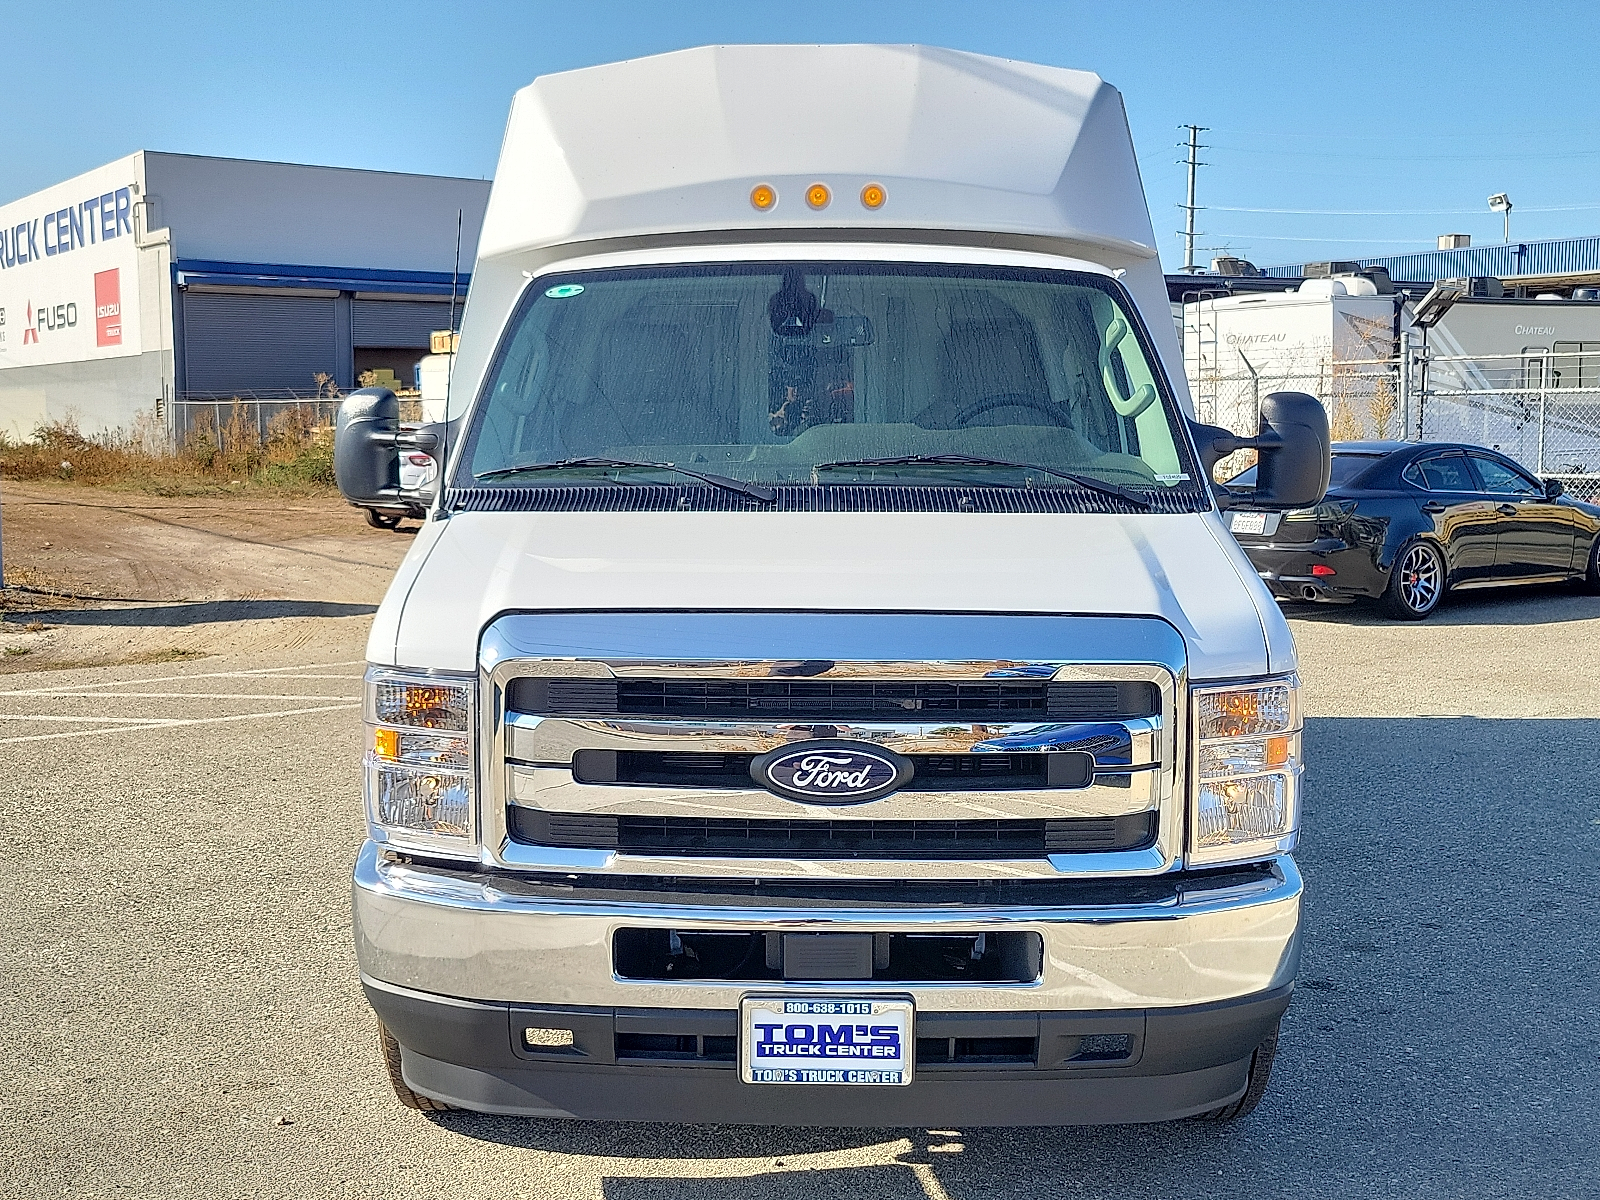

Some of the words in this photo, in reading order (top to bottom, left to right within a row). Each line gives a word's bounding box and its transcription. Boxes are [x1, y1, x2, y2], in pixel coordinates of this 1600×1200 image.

[44, 186, 132, 257] CENTER
[37, 302, 77, 332] FUSO
[97, 302, 120, 318] ISUZU
[793, 756, 872, 787] Ford
[786, 1002, 869, 1014] 800-638-1015
[754, 1024, 901, 1045] TOM'S
[761, 1044, 821, 1056] TRUCK
[825, 1045, 896, 1057] CENTER
[755, 1069, 797, 1082] TOM'S
[801, 1070, 844, 1082] TRUCK
[848, 1071, 899, 1083] CENTER
